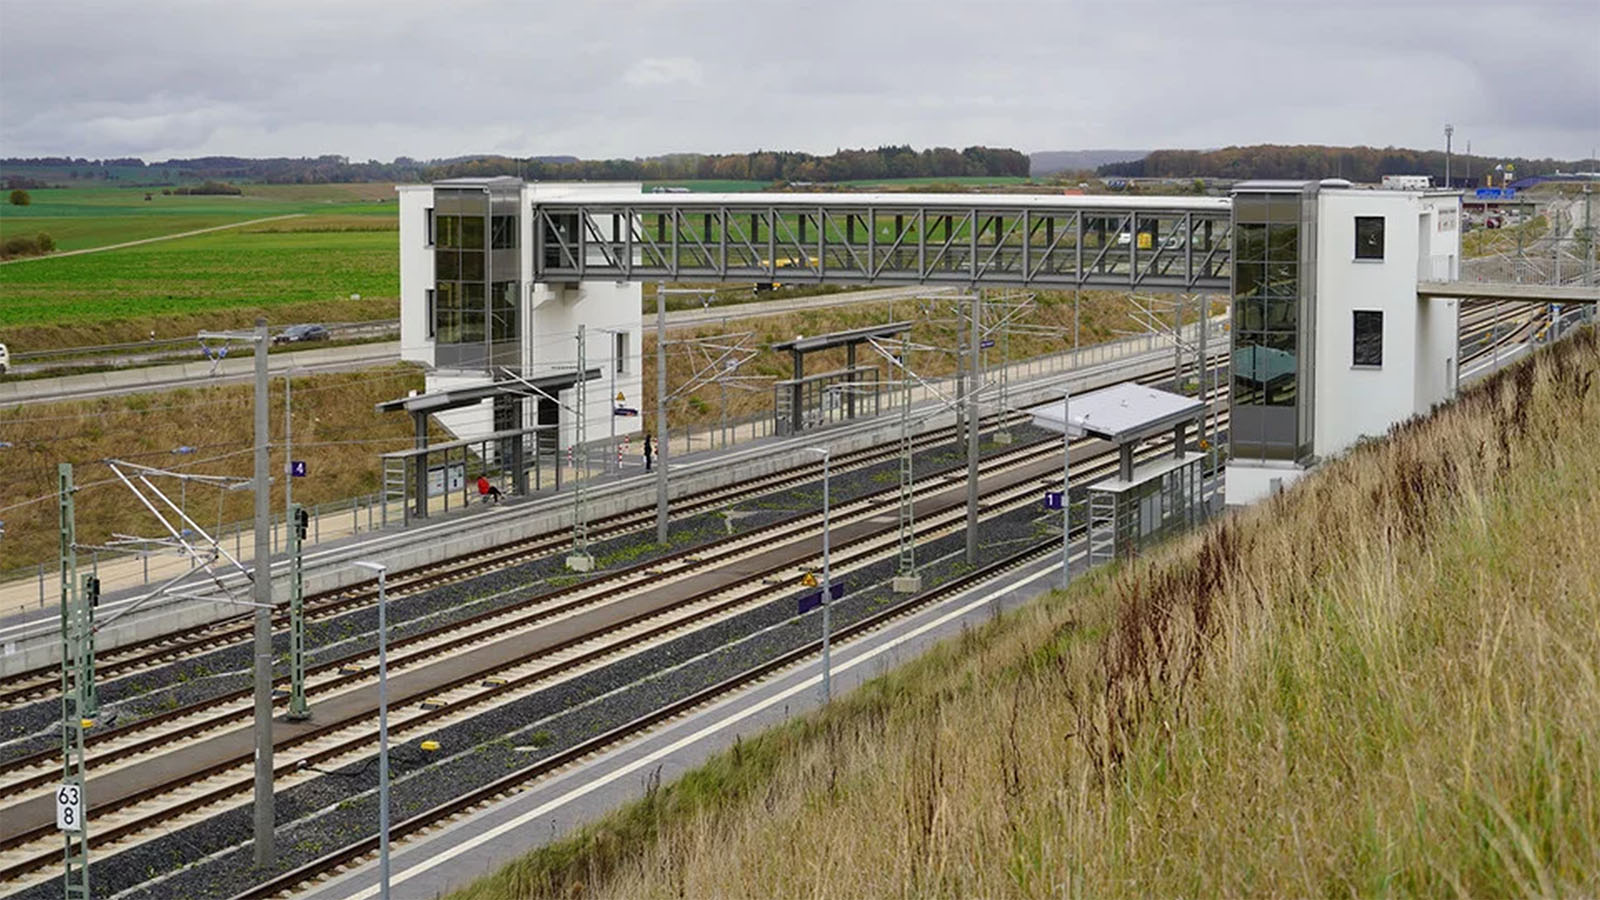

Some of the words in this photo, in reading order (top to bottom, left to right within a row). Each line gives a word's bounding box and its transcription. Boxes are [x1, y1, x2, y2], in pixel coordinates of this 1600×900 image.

[296, 462, 303, 474] 4
[1048, 493, 1053, 506] 1
[59, 787, 79, 805] 63
[64, 807, 74, 825] 8
